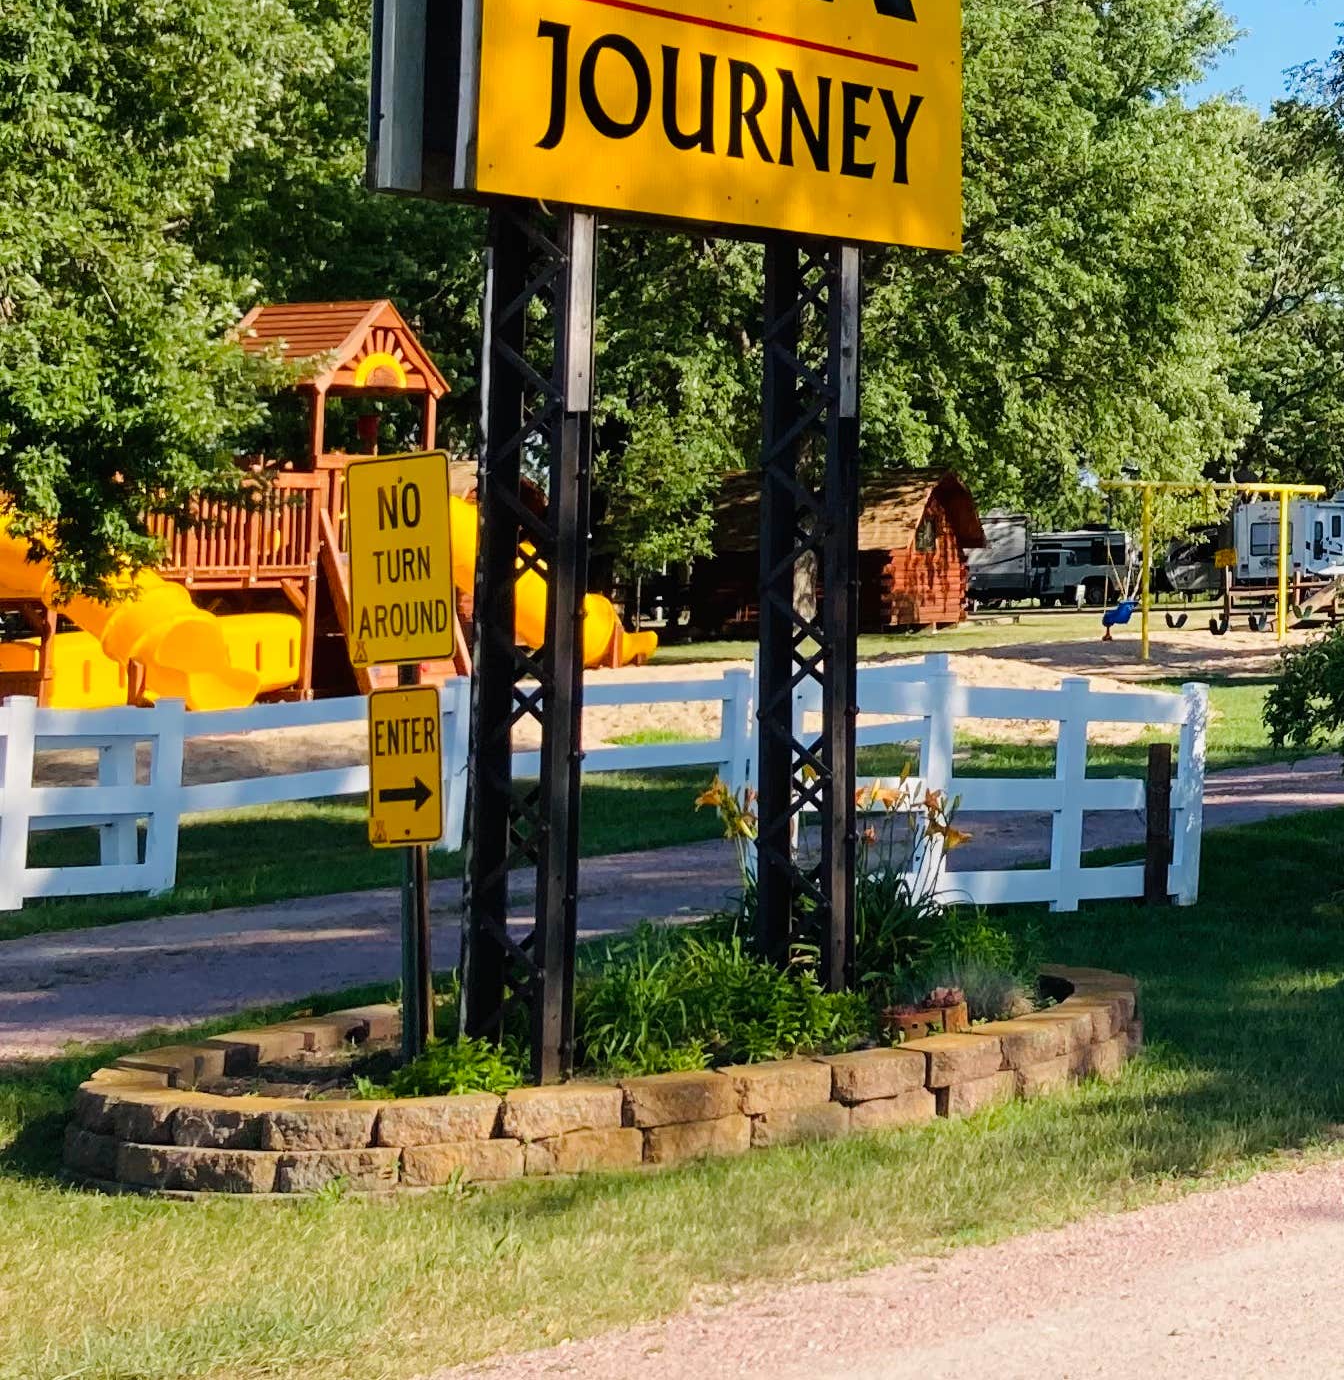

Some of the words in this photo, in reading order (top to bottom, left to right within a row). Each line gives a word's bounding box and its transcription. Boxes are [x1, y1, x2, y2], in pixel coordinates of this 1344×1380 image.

[535, 19, 924, 185] JOURNEY
[377, 481, 421, 532] NO
[373, 545, 431, 585] TURN
[358, 598, 448, 639] AROUND
[375, 716, 436, 757] ENTER
